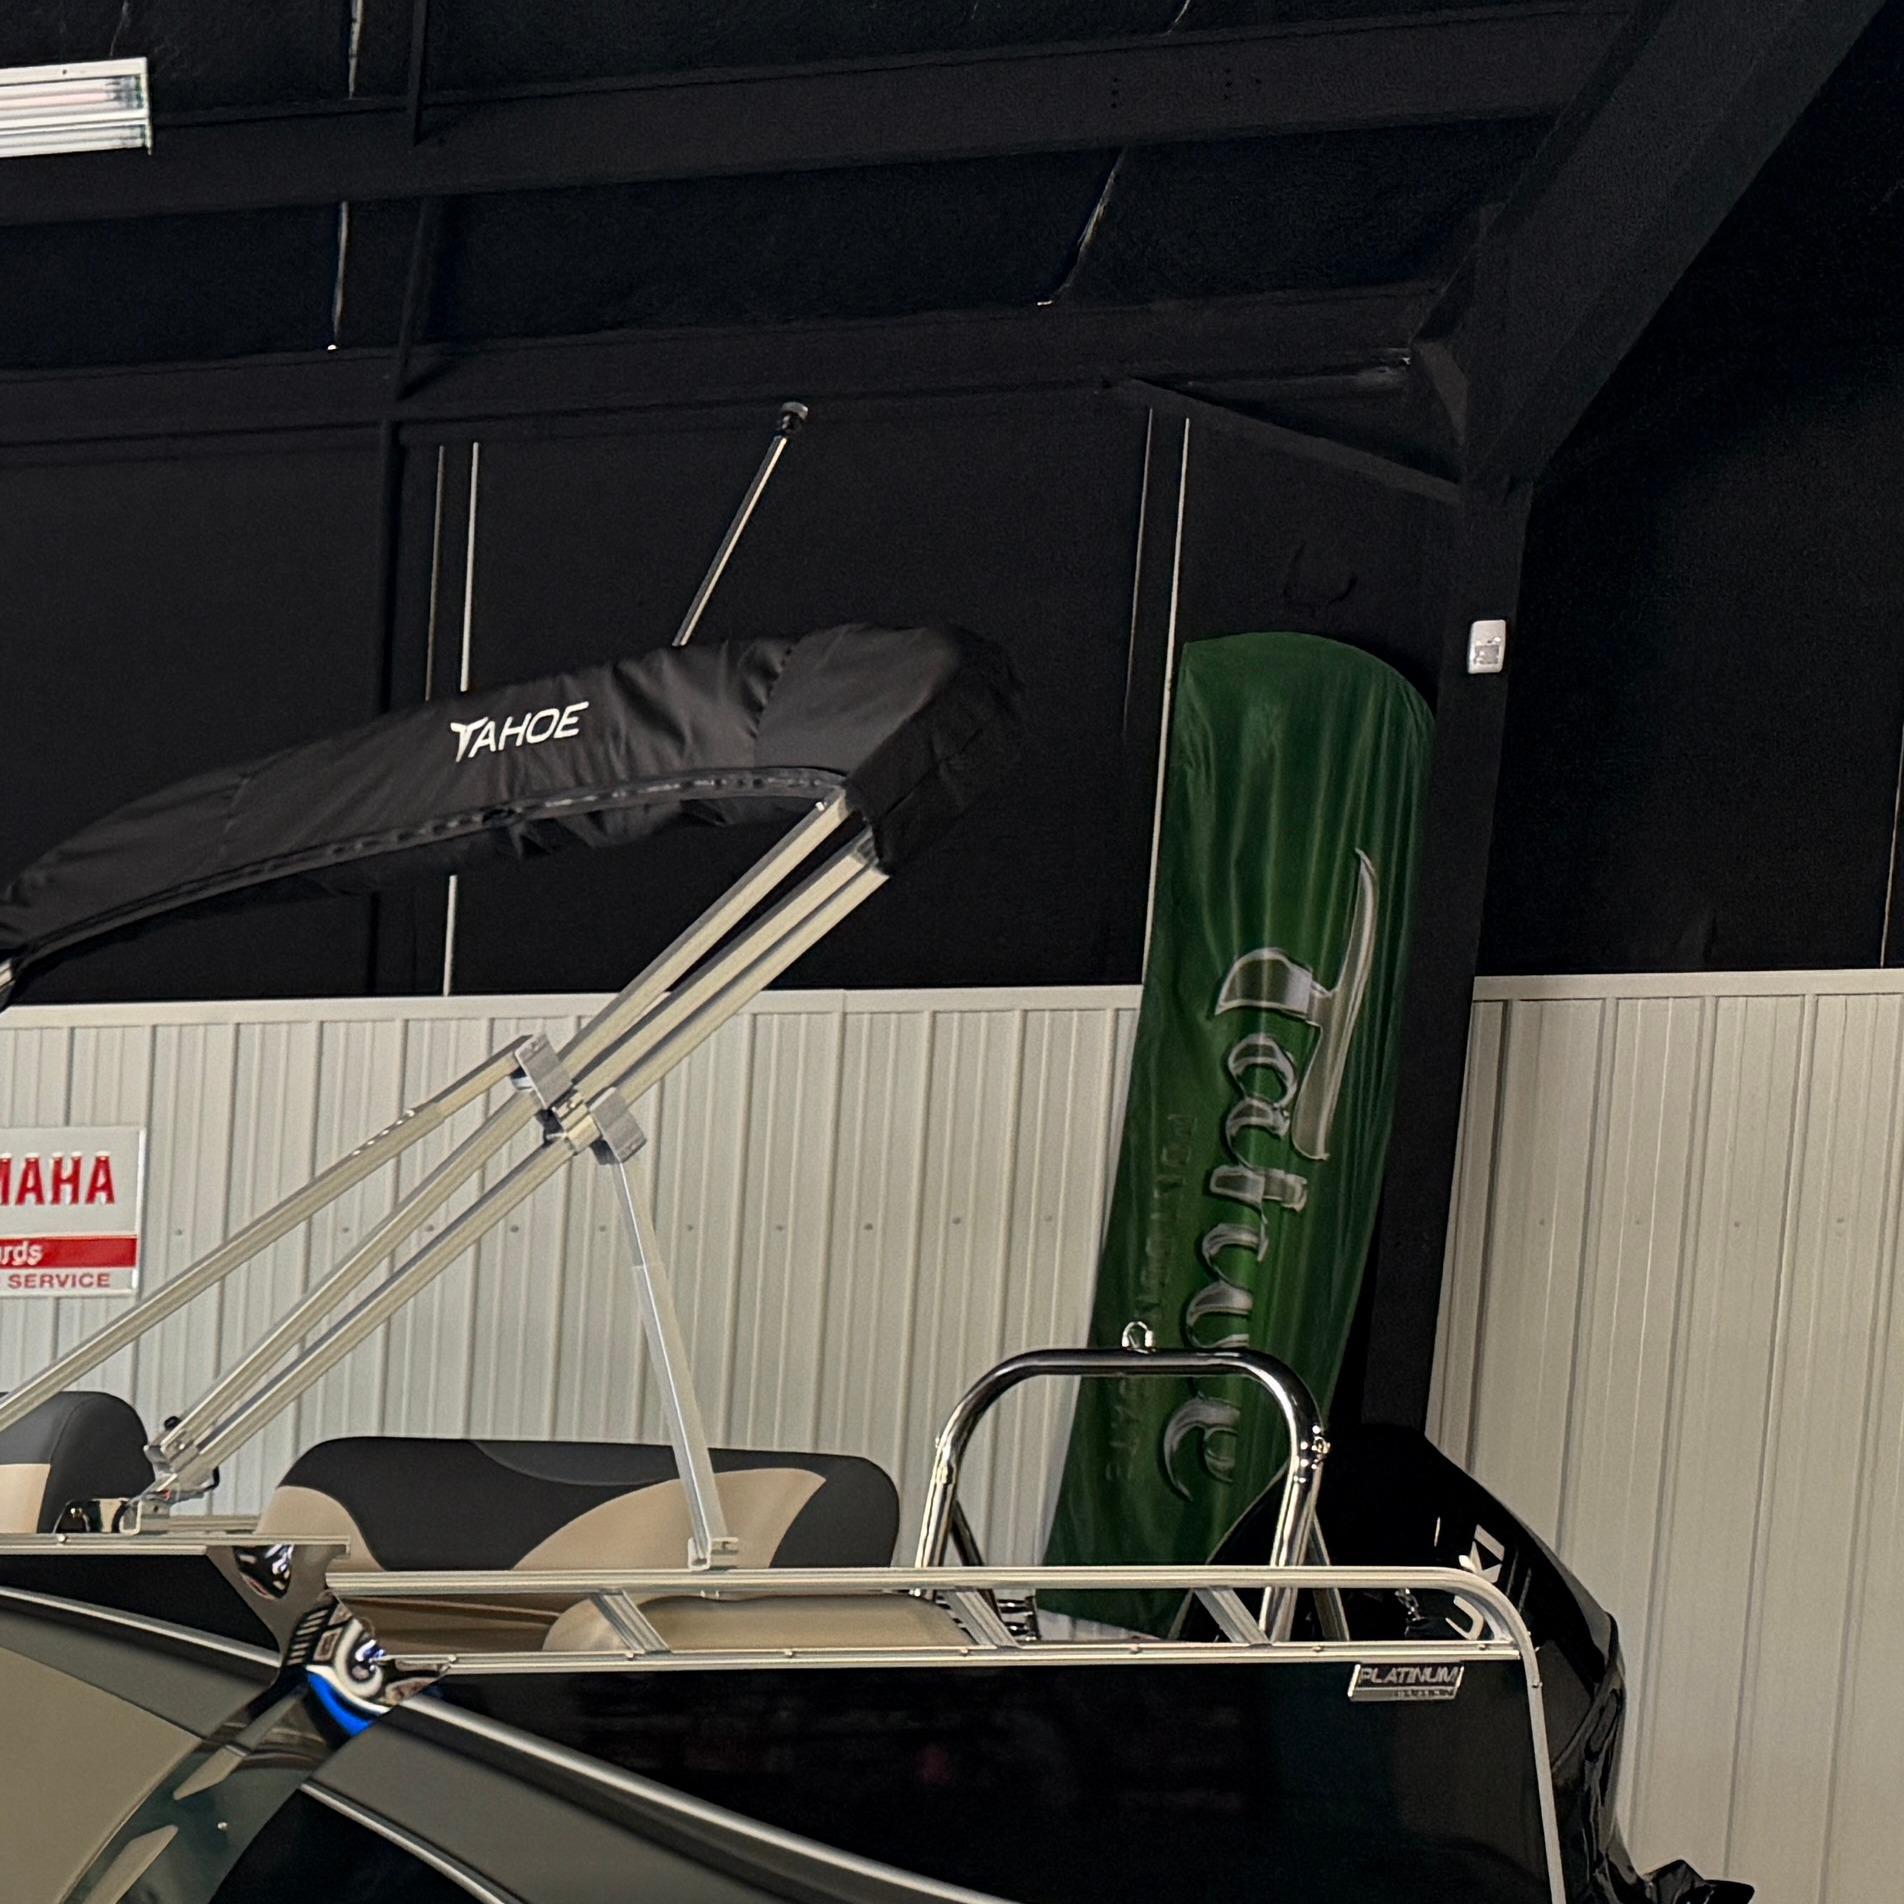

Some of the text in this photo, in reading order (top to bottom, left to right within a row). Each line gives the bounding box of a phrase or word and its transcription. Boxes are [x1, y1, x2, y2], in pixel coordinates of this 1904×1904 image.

[450, 701, 589, 762] TAHOE
[7, 1271, 112, 1289] SERVICE
[1357, 1666, 1461, 1685] PLATINUM
